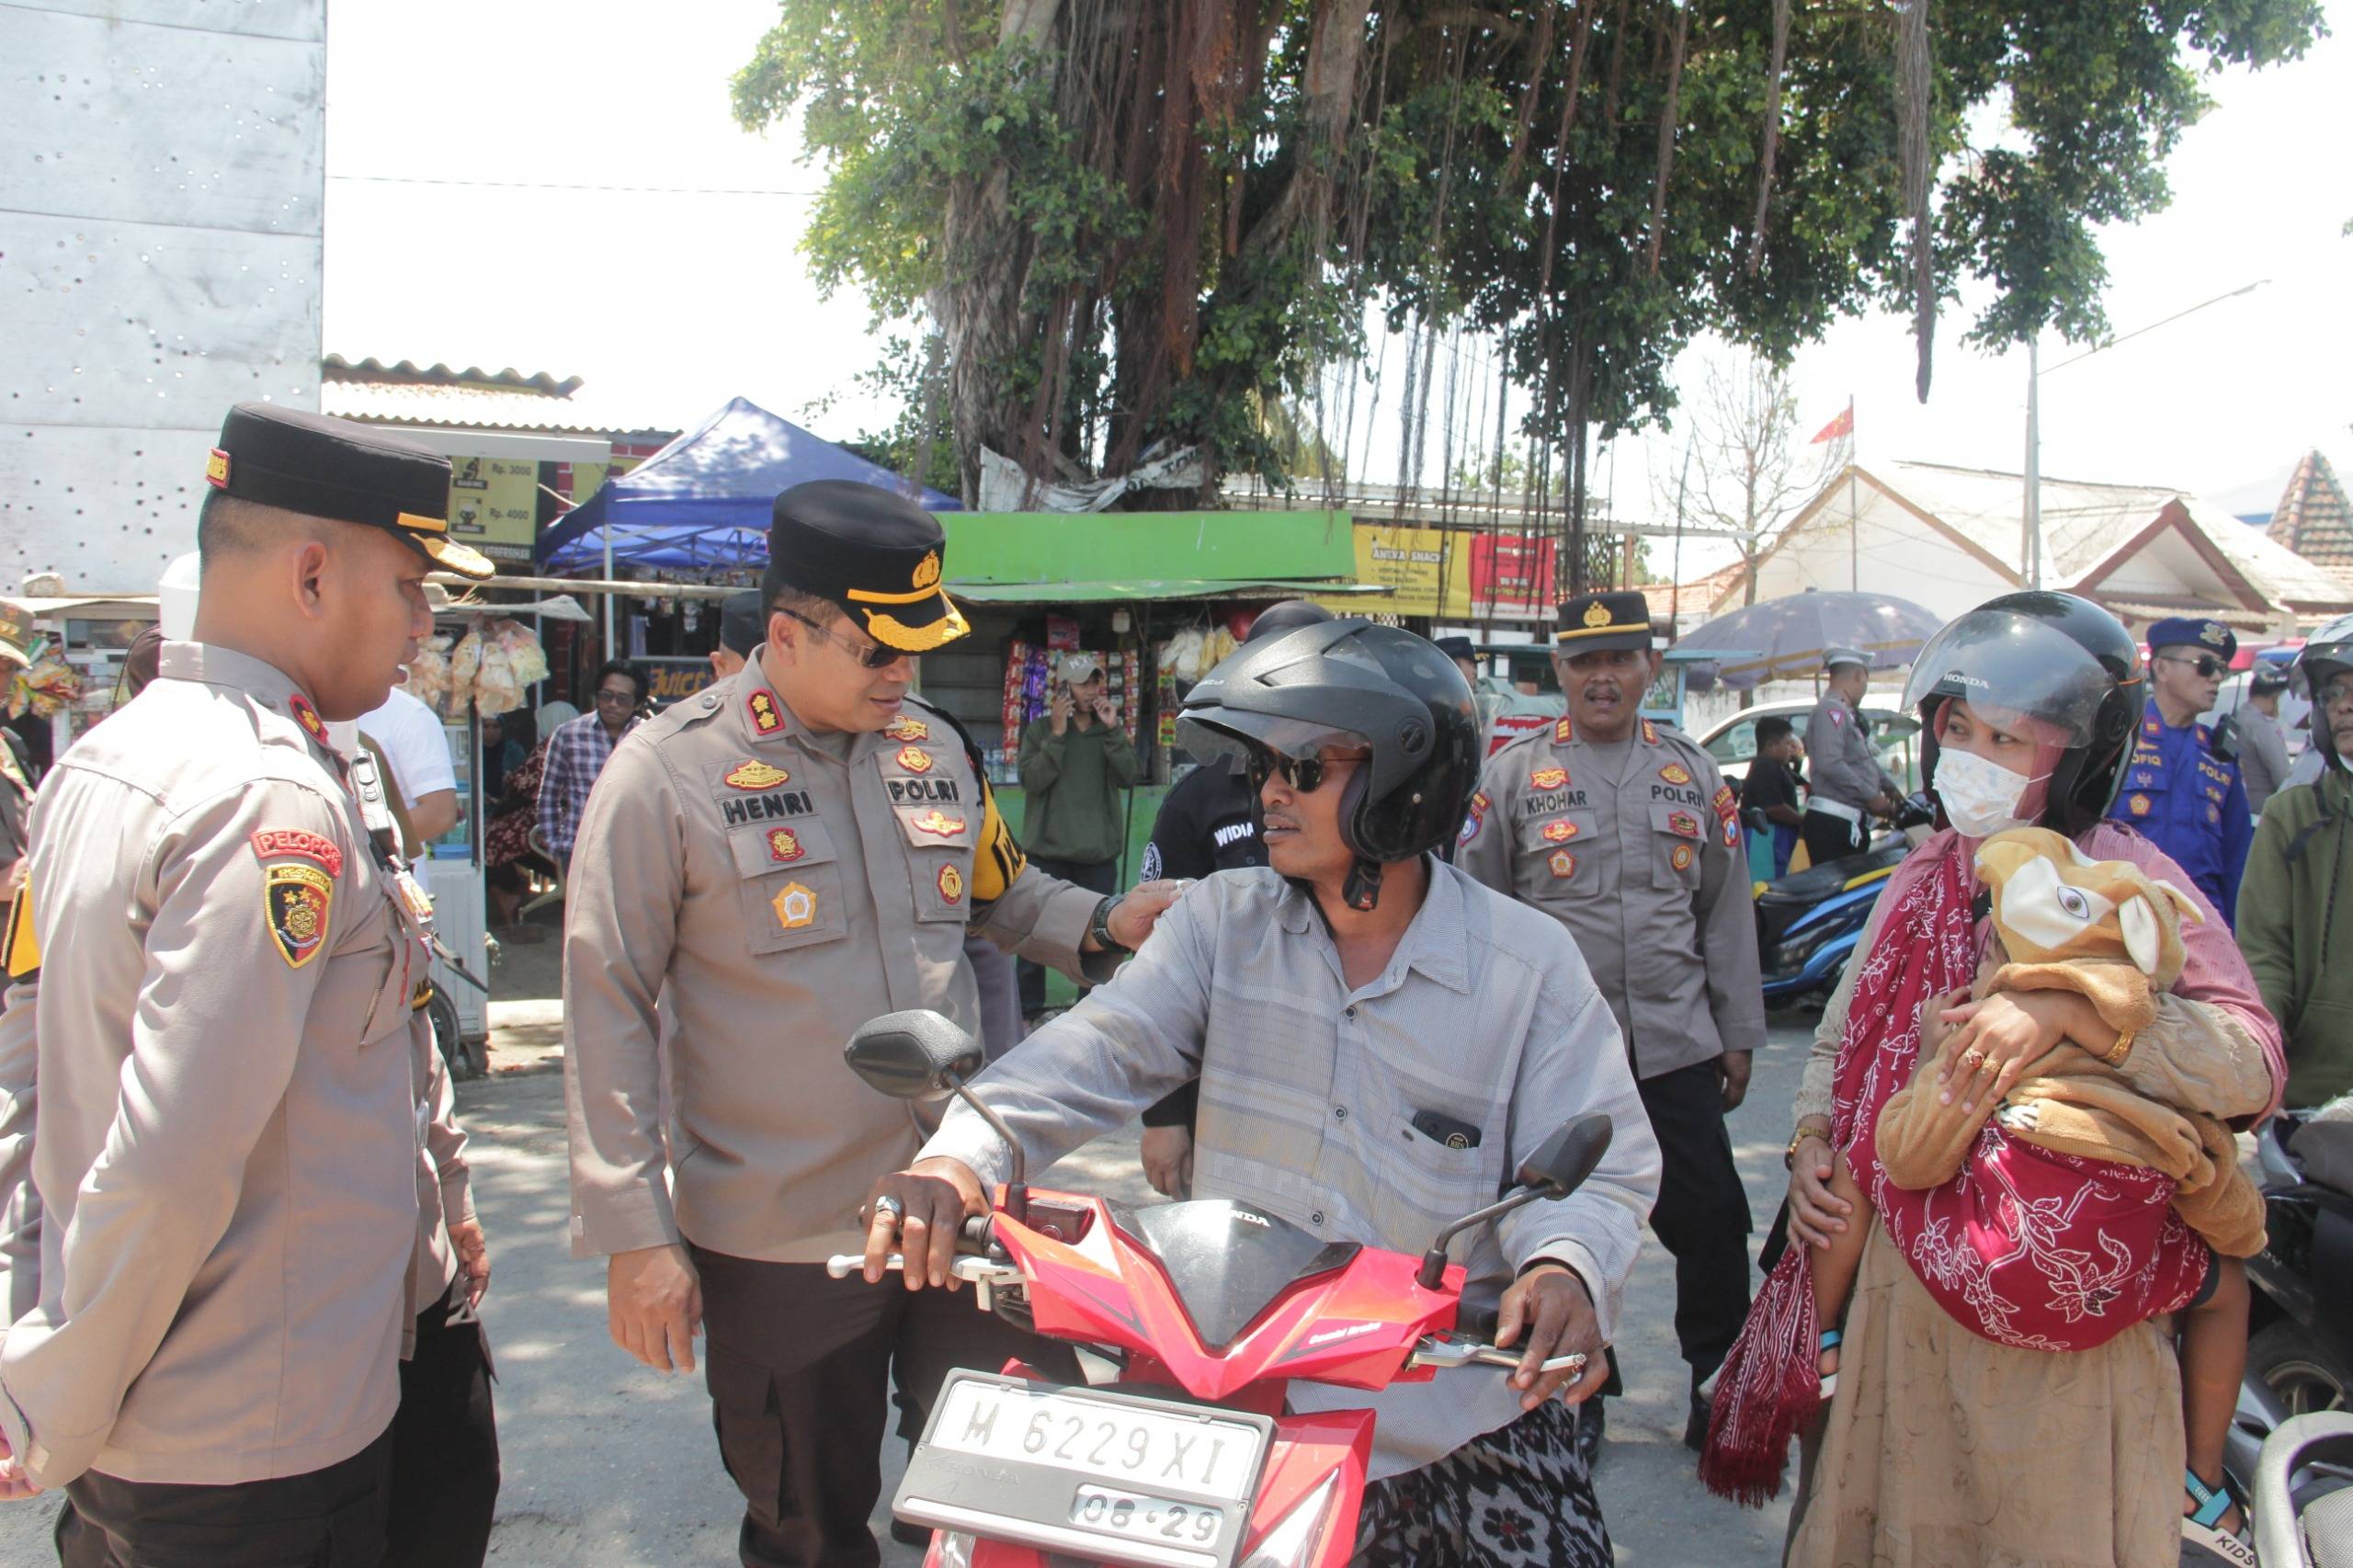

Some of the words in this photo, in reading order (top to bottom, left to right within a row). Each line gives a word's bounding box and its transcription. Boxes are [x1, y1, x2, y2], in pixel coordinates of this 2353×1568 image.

[1943, 673, 1990, 689] HONDA
[888, 779, 960, 801] POLRI
[1526, 790, 1587, 814] KHOHAR
[1651, 784, 1702, 808] POLRI
[722, 790, 813, 824] HENRI
[1023, 1409, 1150, 1471] 6229
[2216, 1535, 2254, 1566] KIDS
